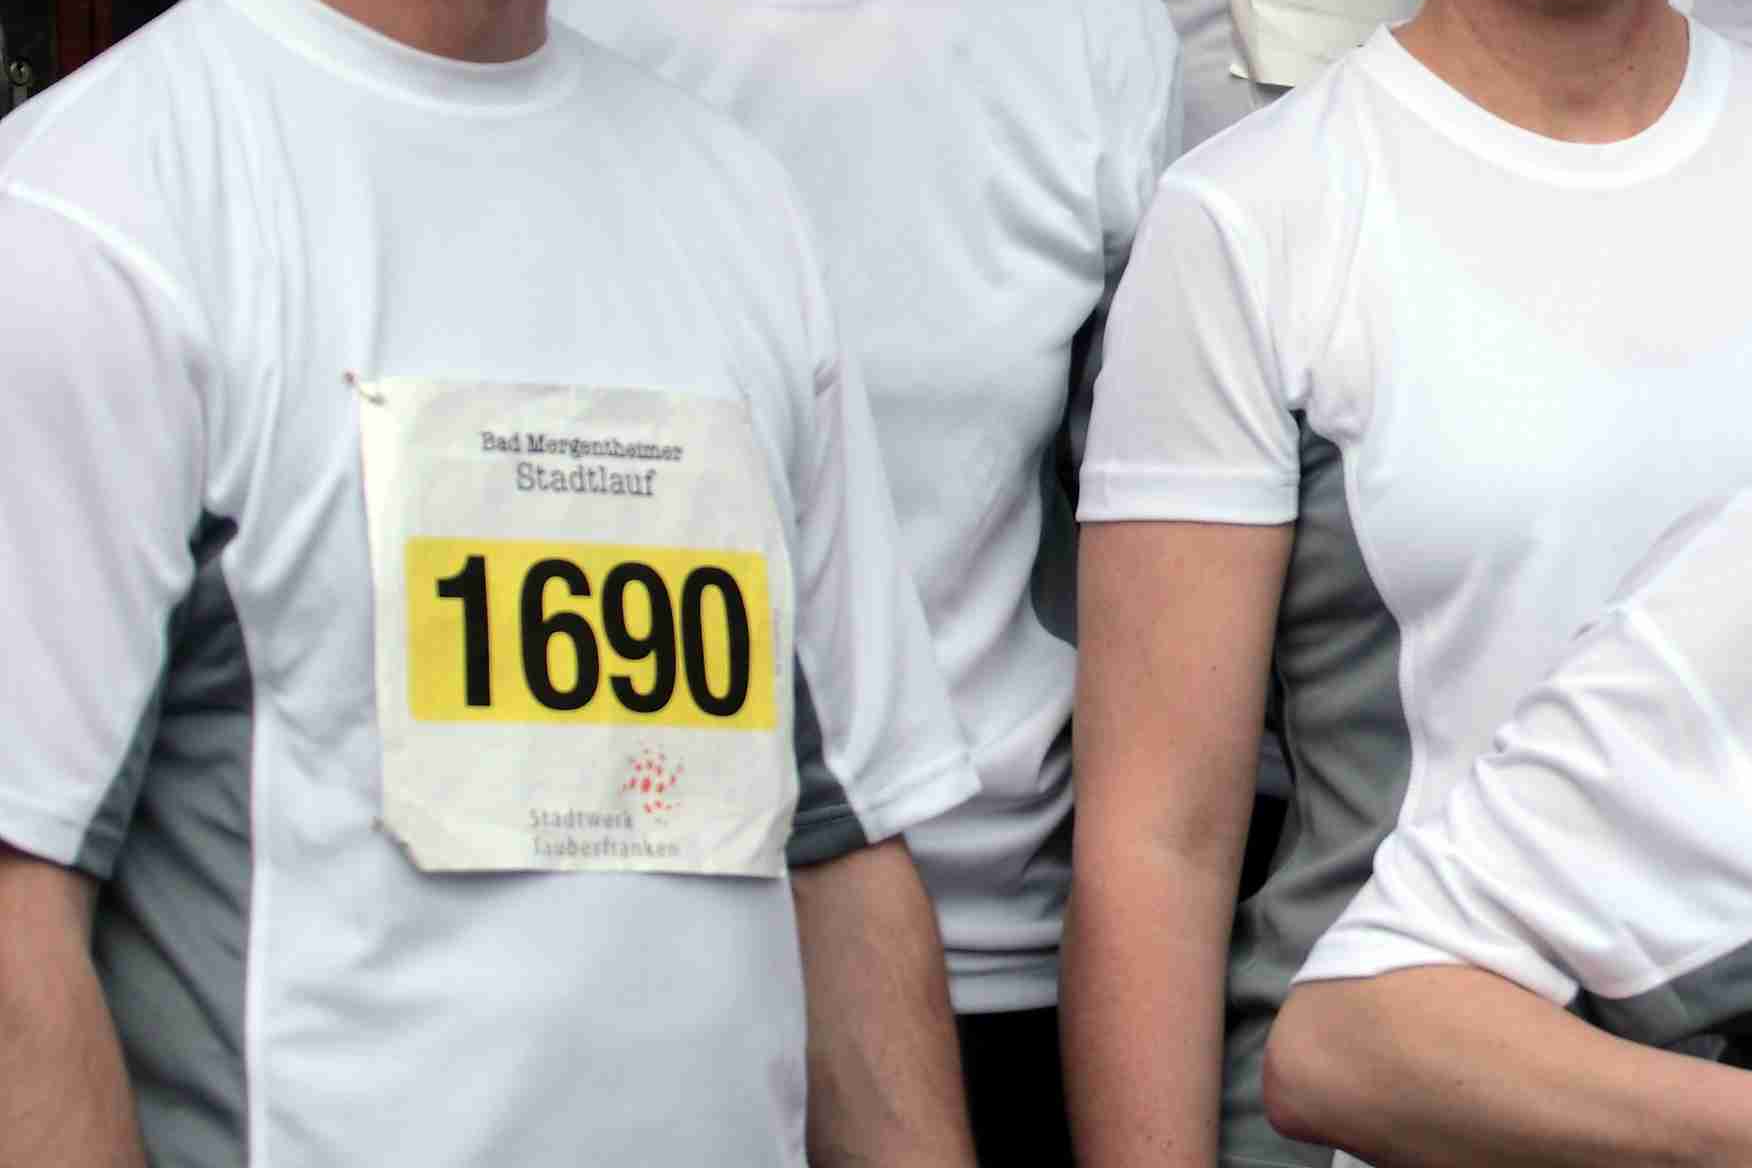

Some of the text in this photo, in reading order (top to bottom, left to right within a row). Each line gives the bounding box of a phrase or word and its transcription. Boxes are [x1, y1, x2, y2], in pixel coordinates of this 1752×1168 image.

[482, 431, 683, 461] Bad Mergentheimer
[516, 461, 656, 497] Stadtlauf
[437, 555, 750, 716] 1690
[529, 808, 634, 829] Stadtwerk
[533, 836, 681, 858] Tauberfranken
